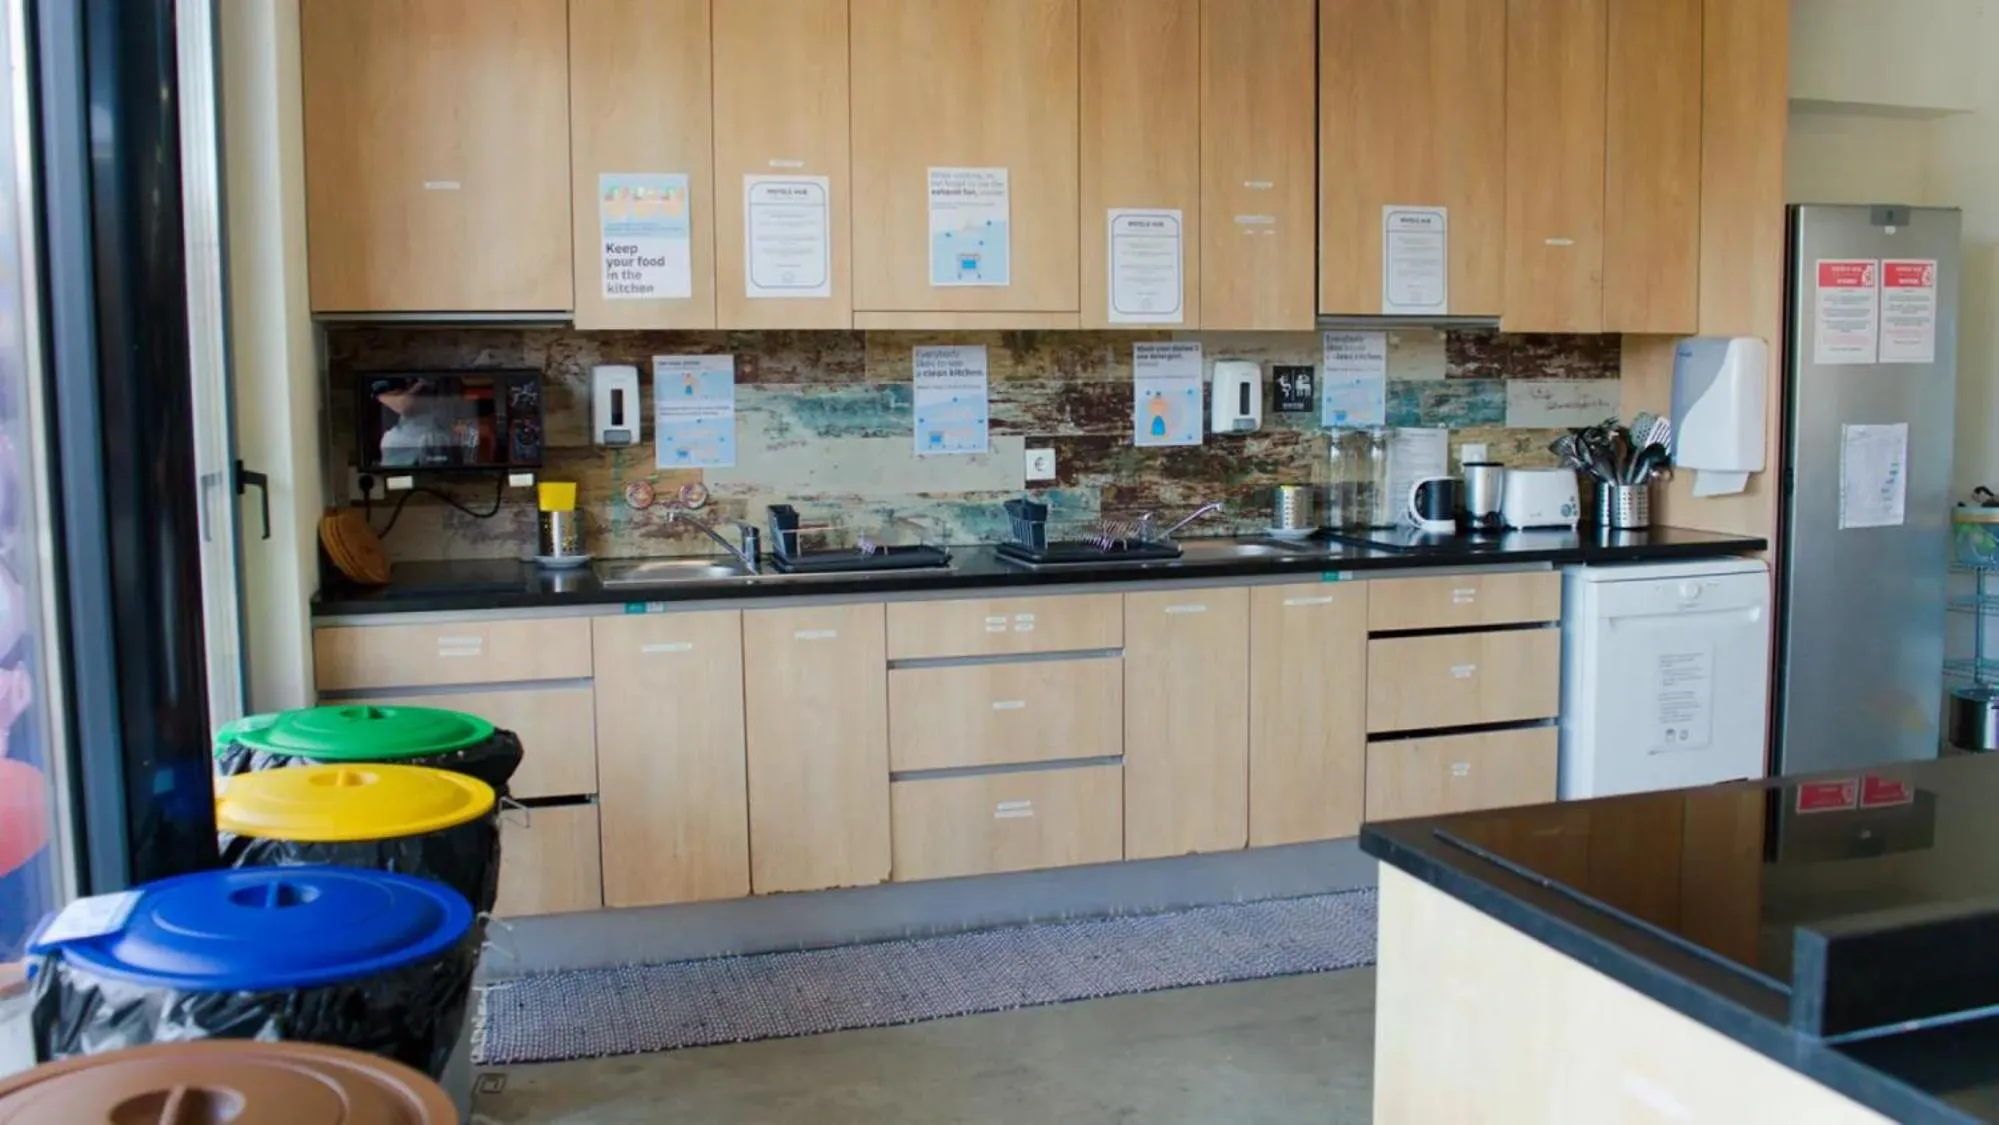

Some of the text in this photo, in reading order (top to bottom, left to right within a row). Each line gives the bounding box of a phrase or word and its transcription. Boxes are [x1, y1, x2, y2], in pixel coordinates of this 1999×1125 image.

[606, 243, 639, 256] Keep
[606, 256, 666, 269] your food
[606, 270, 642, 280] in the
[607, 283, 655, 294] kitchen
